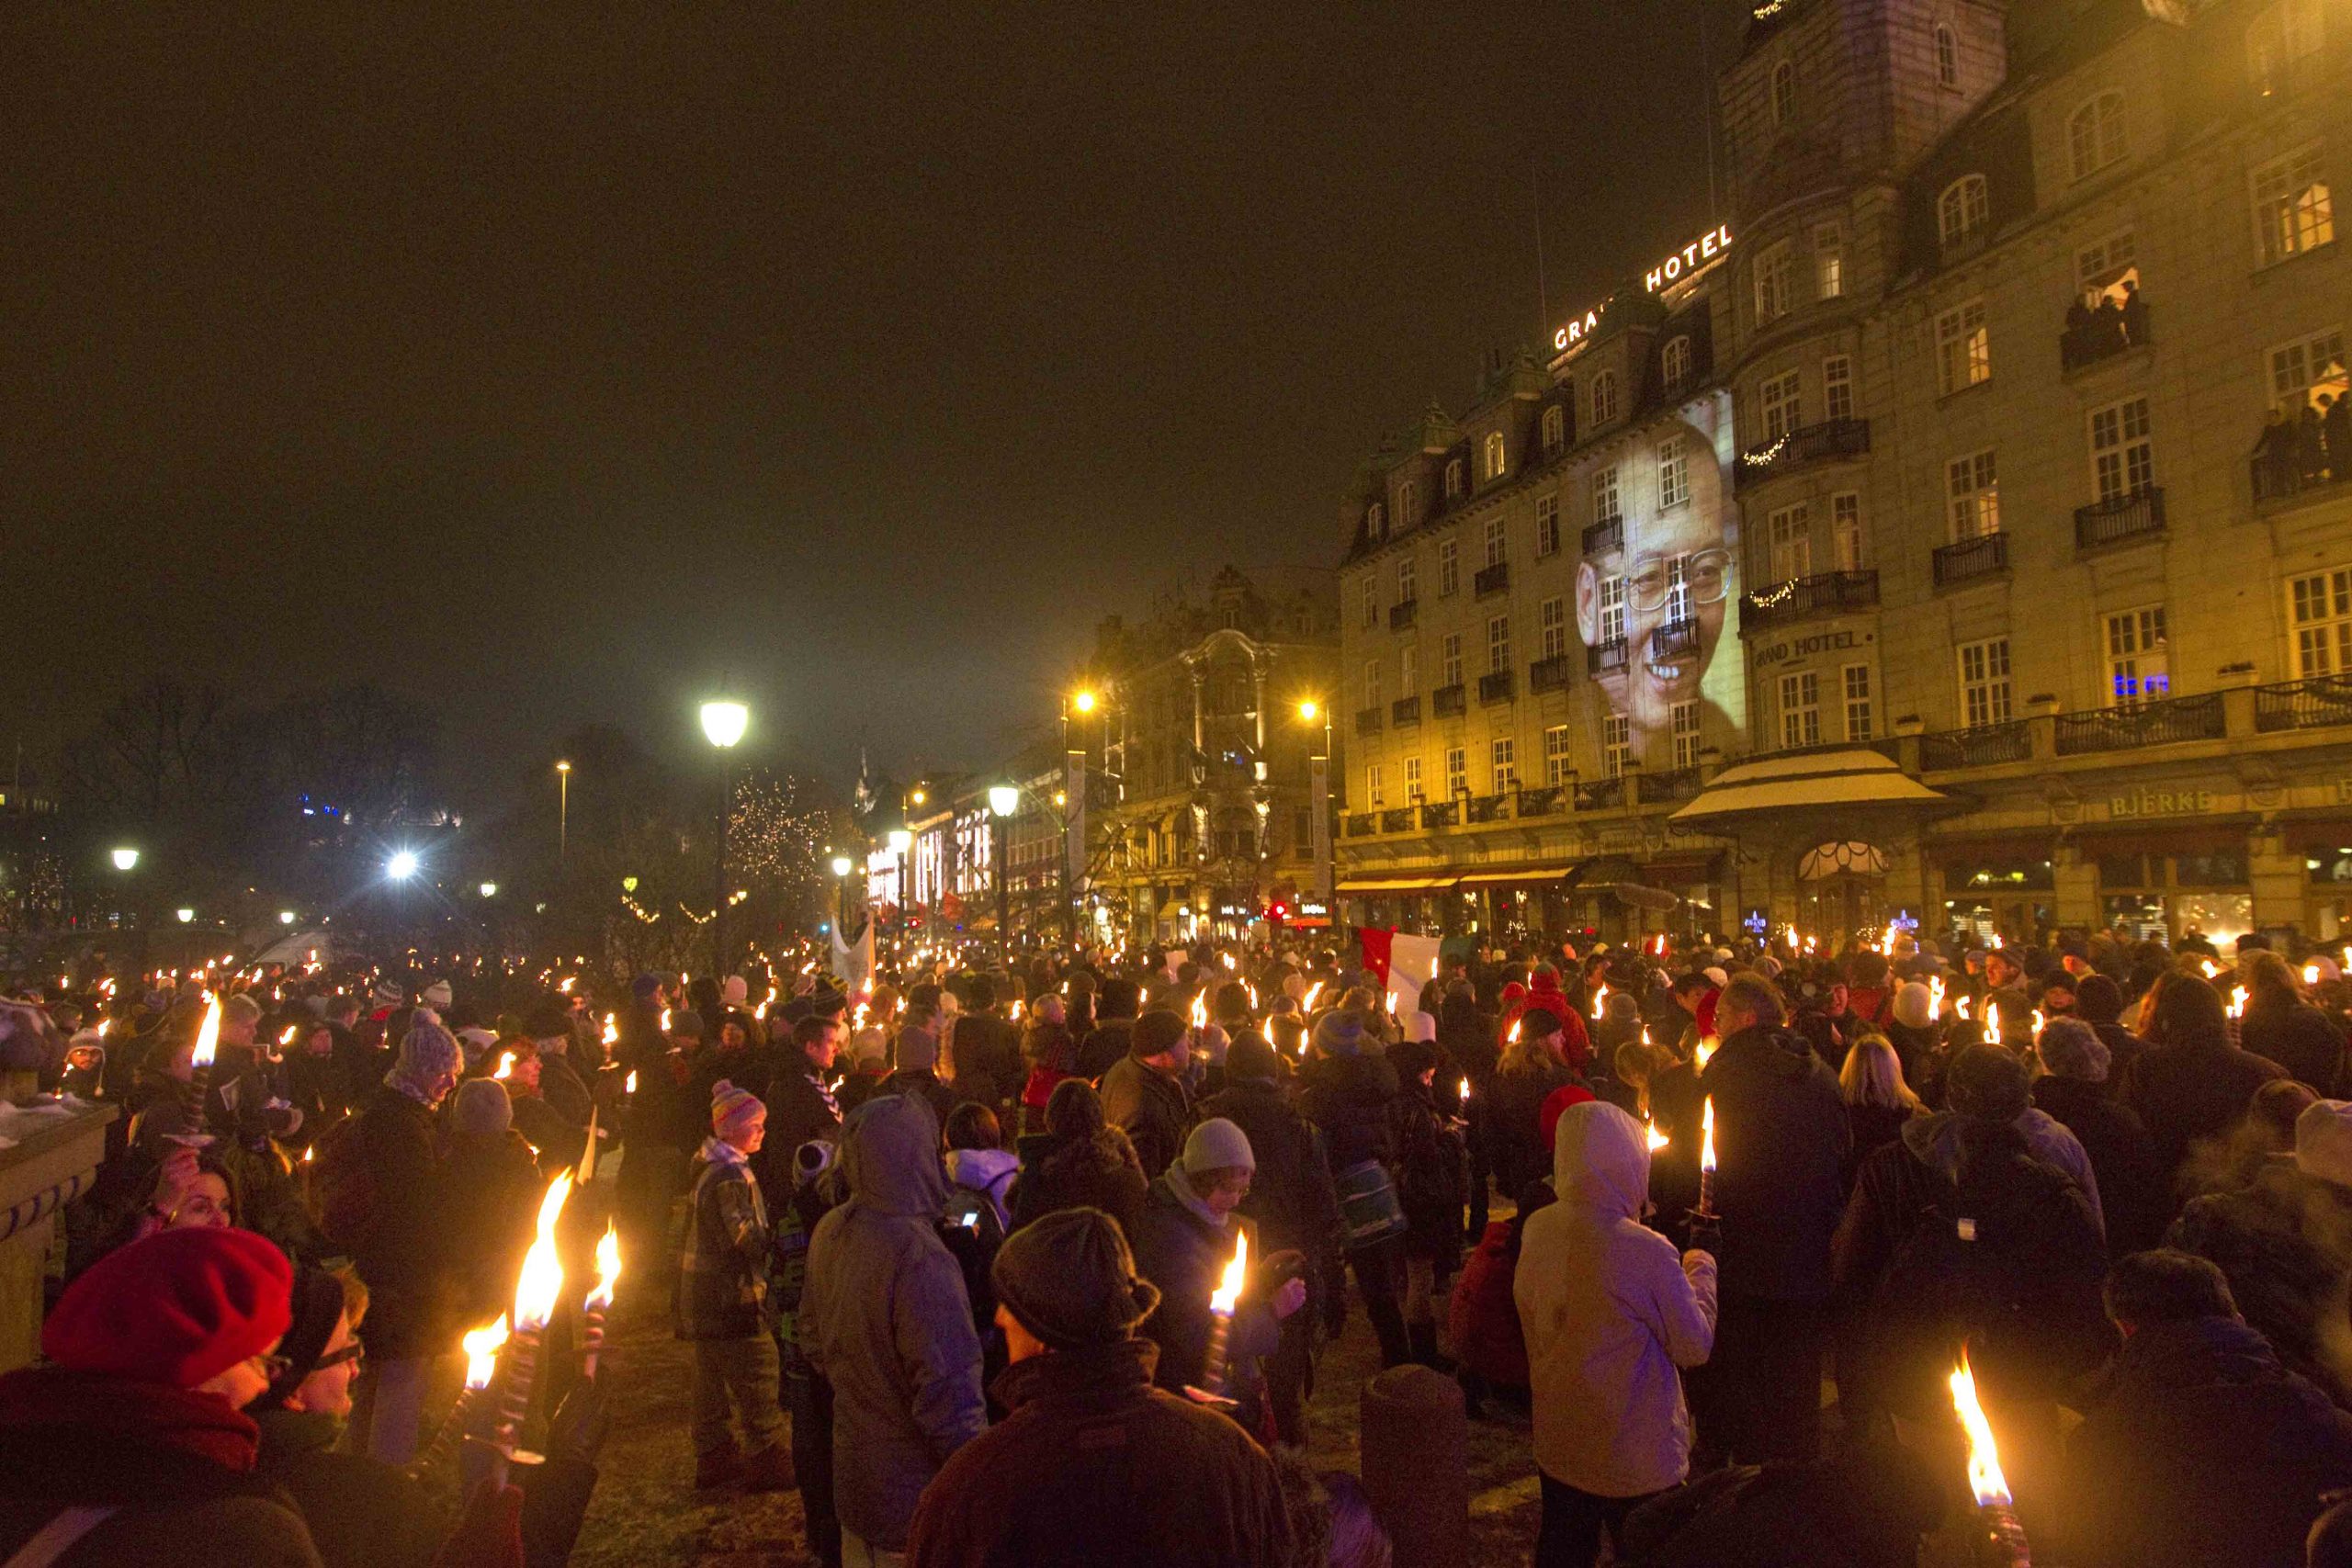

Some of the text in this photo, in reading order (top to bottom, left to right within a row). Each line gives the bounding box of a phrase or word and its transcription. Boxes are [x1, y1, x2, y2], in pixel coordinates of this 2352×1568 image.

[1555, 225, 1732, 350] GRA HOTEL
[1795, 632, 1862, 656] HOTEL
[2112, 792, 2210, 816] BJERKE
